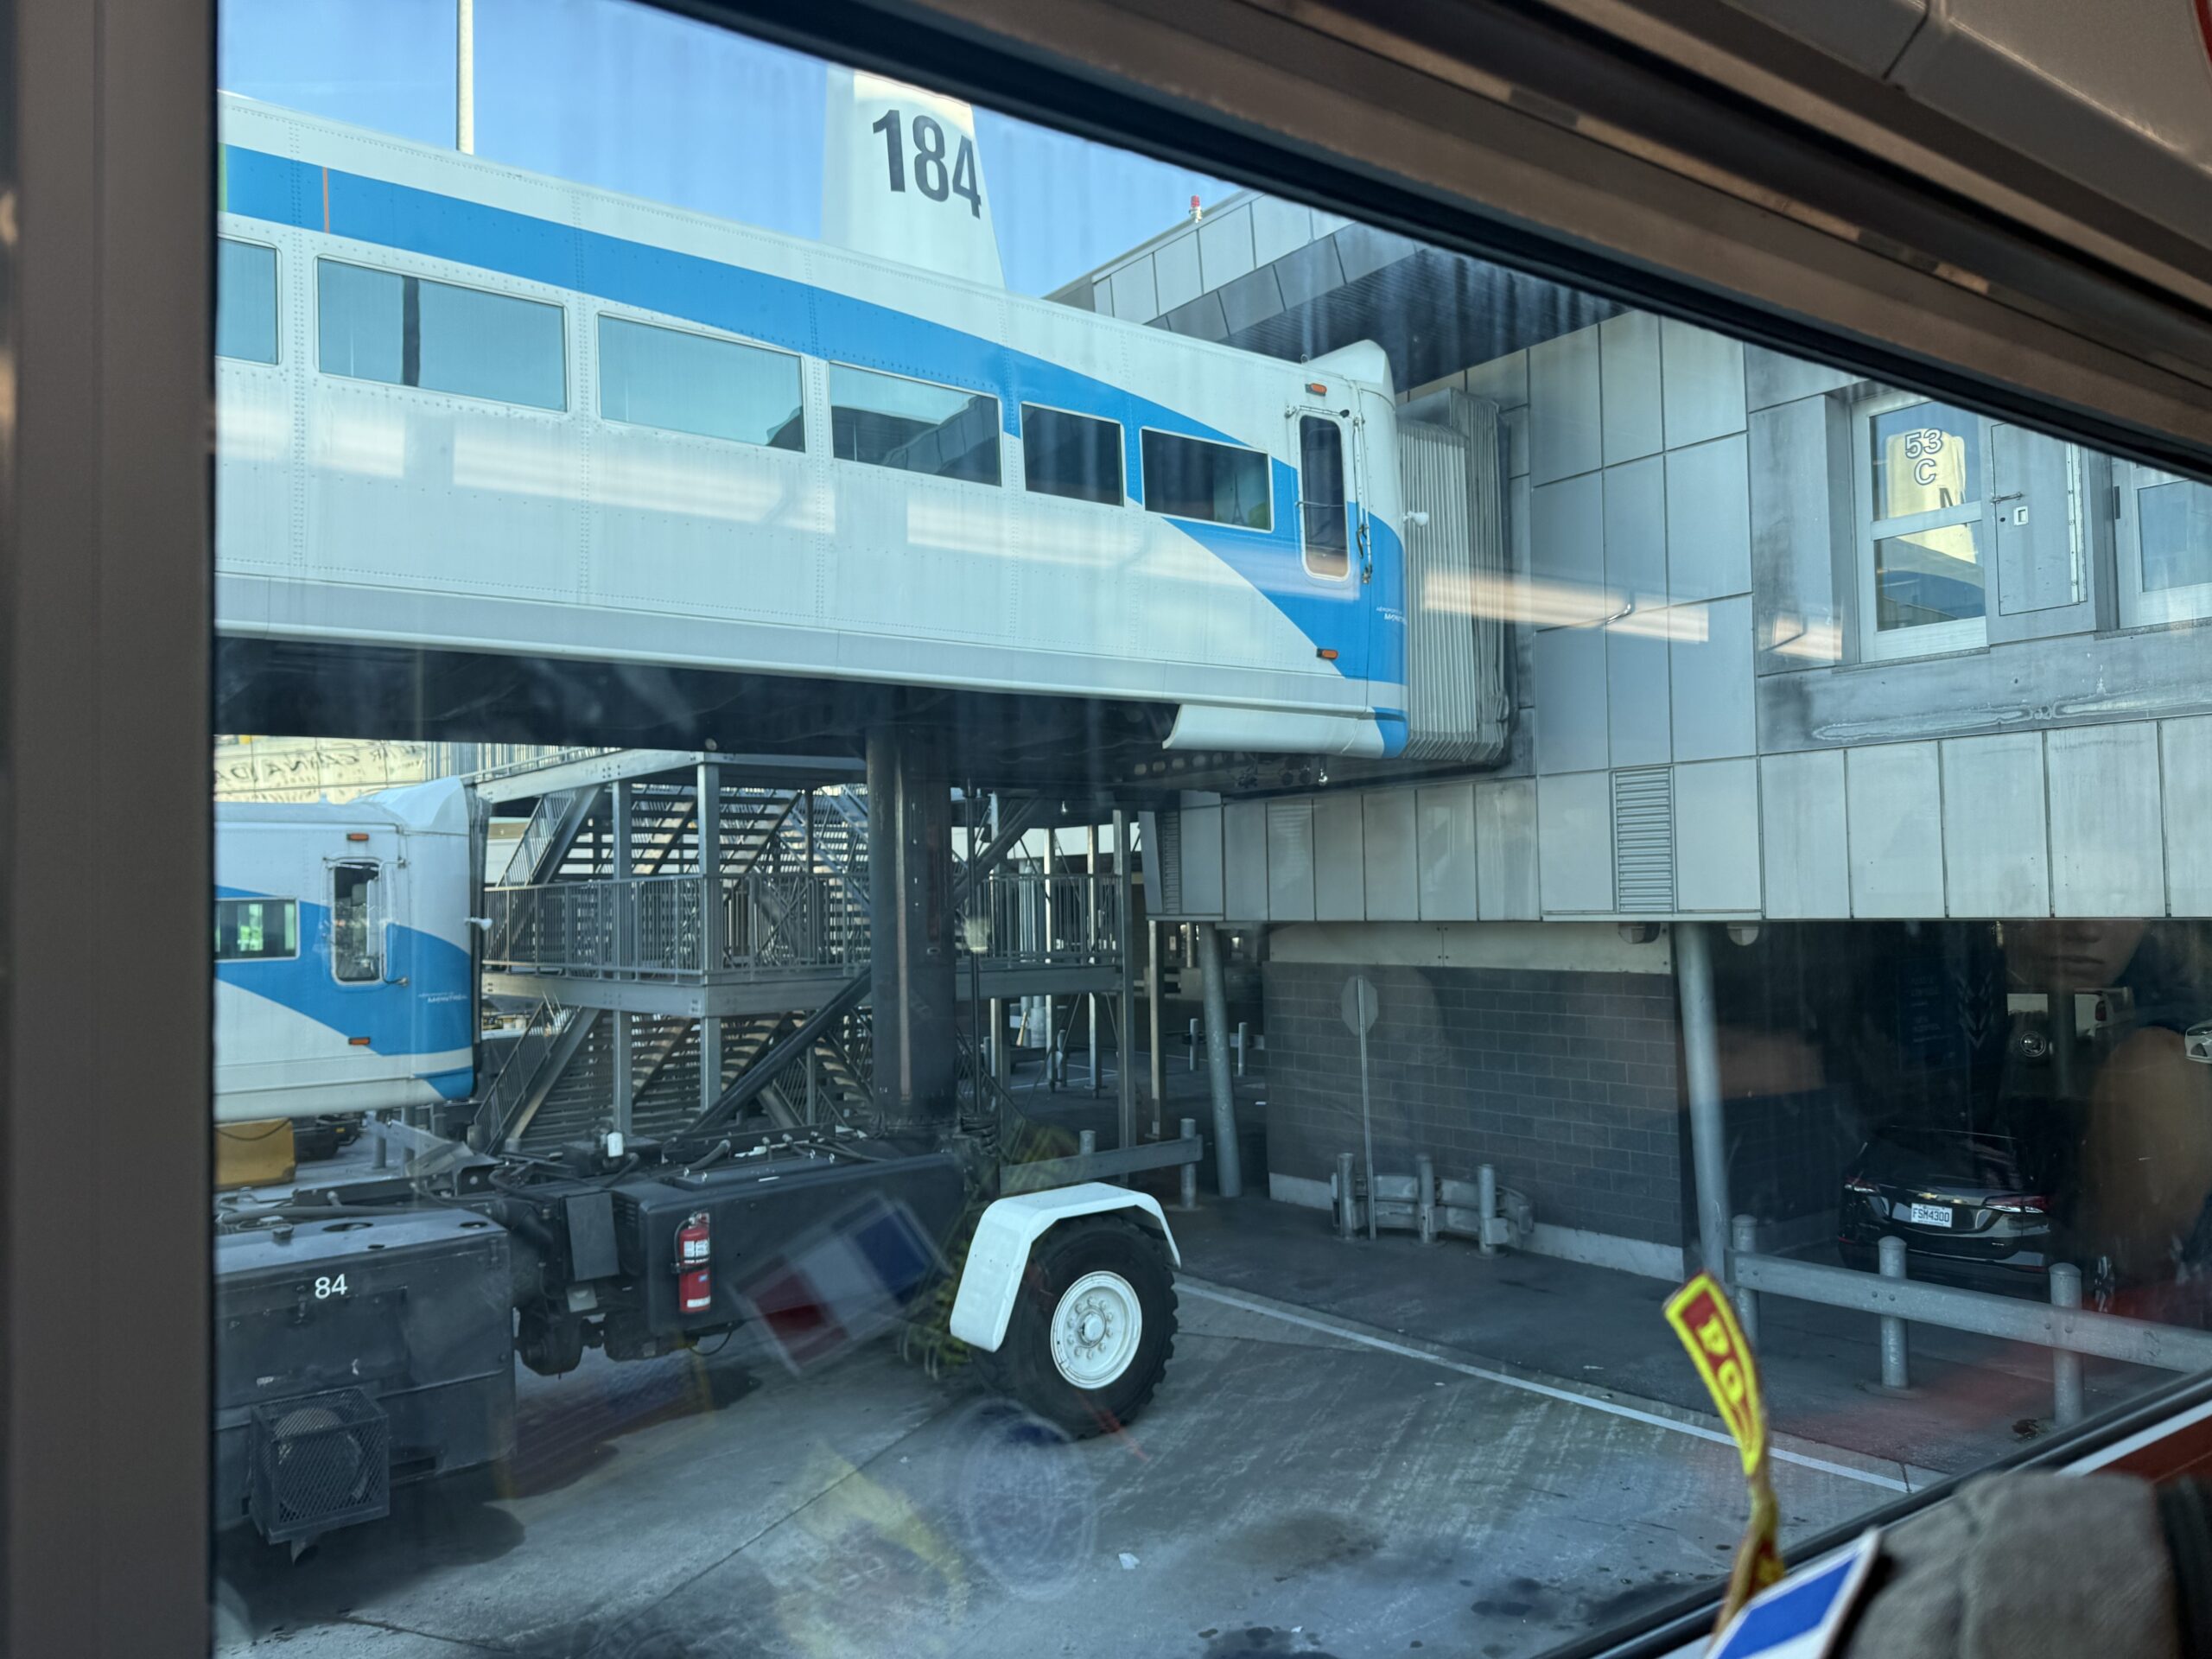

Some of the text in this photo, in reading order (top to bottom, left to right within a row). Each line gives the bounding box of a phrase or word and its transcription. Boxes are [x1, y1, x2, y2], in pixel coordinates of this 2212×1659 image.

[873, 109, 982, 219] 184
[1904, 428, 1943, 459] 53
[1914, 458, 1936, 486] C
[315, 1273, 348, 1300] 84
